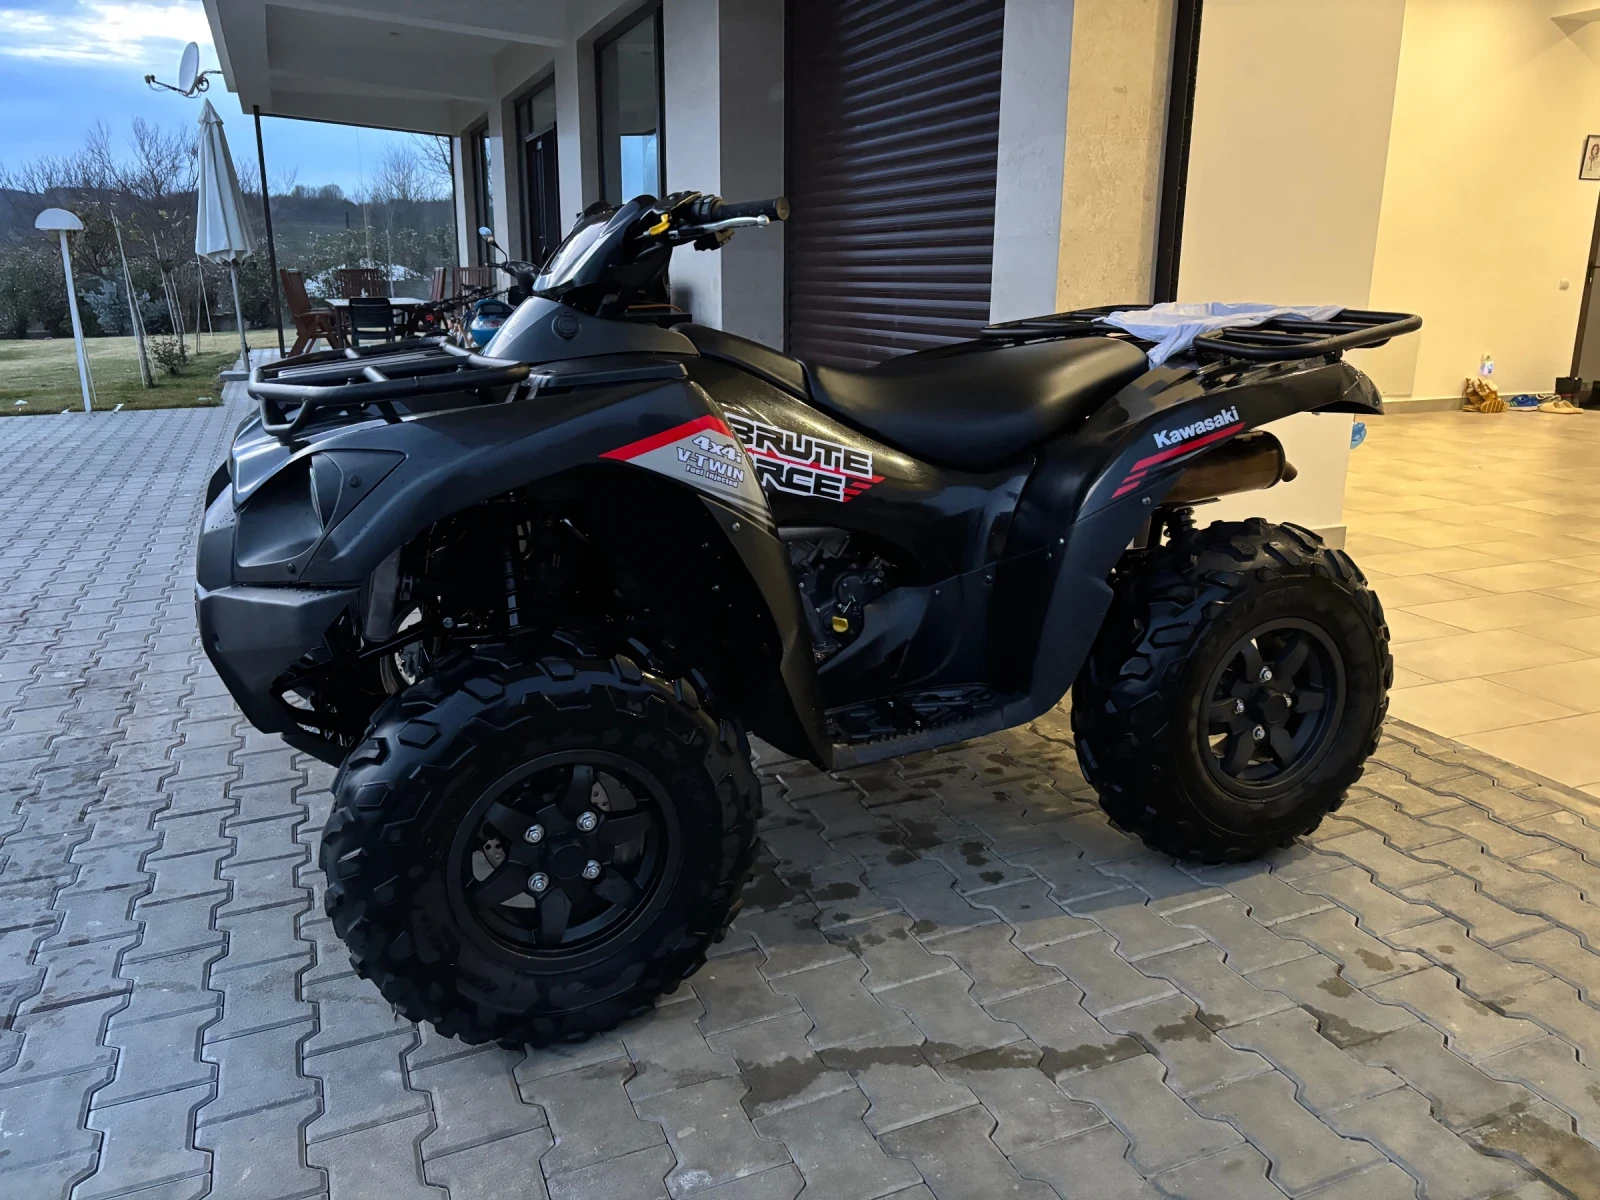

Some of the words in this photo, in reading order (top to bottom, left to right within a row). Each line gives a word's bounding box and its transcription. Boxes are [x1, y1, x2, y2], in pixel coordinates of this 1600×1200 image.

[724, 412, 873, 480] BRUTE
[1153, 405, 1240, 449] Kawasaki
[677, 447, 745, 484] V-TWIN
[685, 464, 705, 477] Fuel
[705, 470, 738, 489] Injected
[749, 451, 846, 503] RCE
